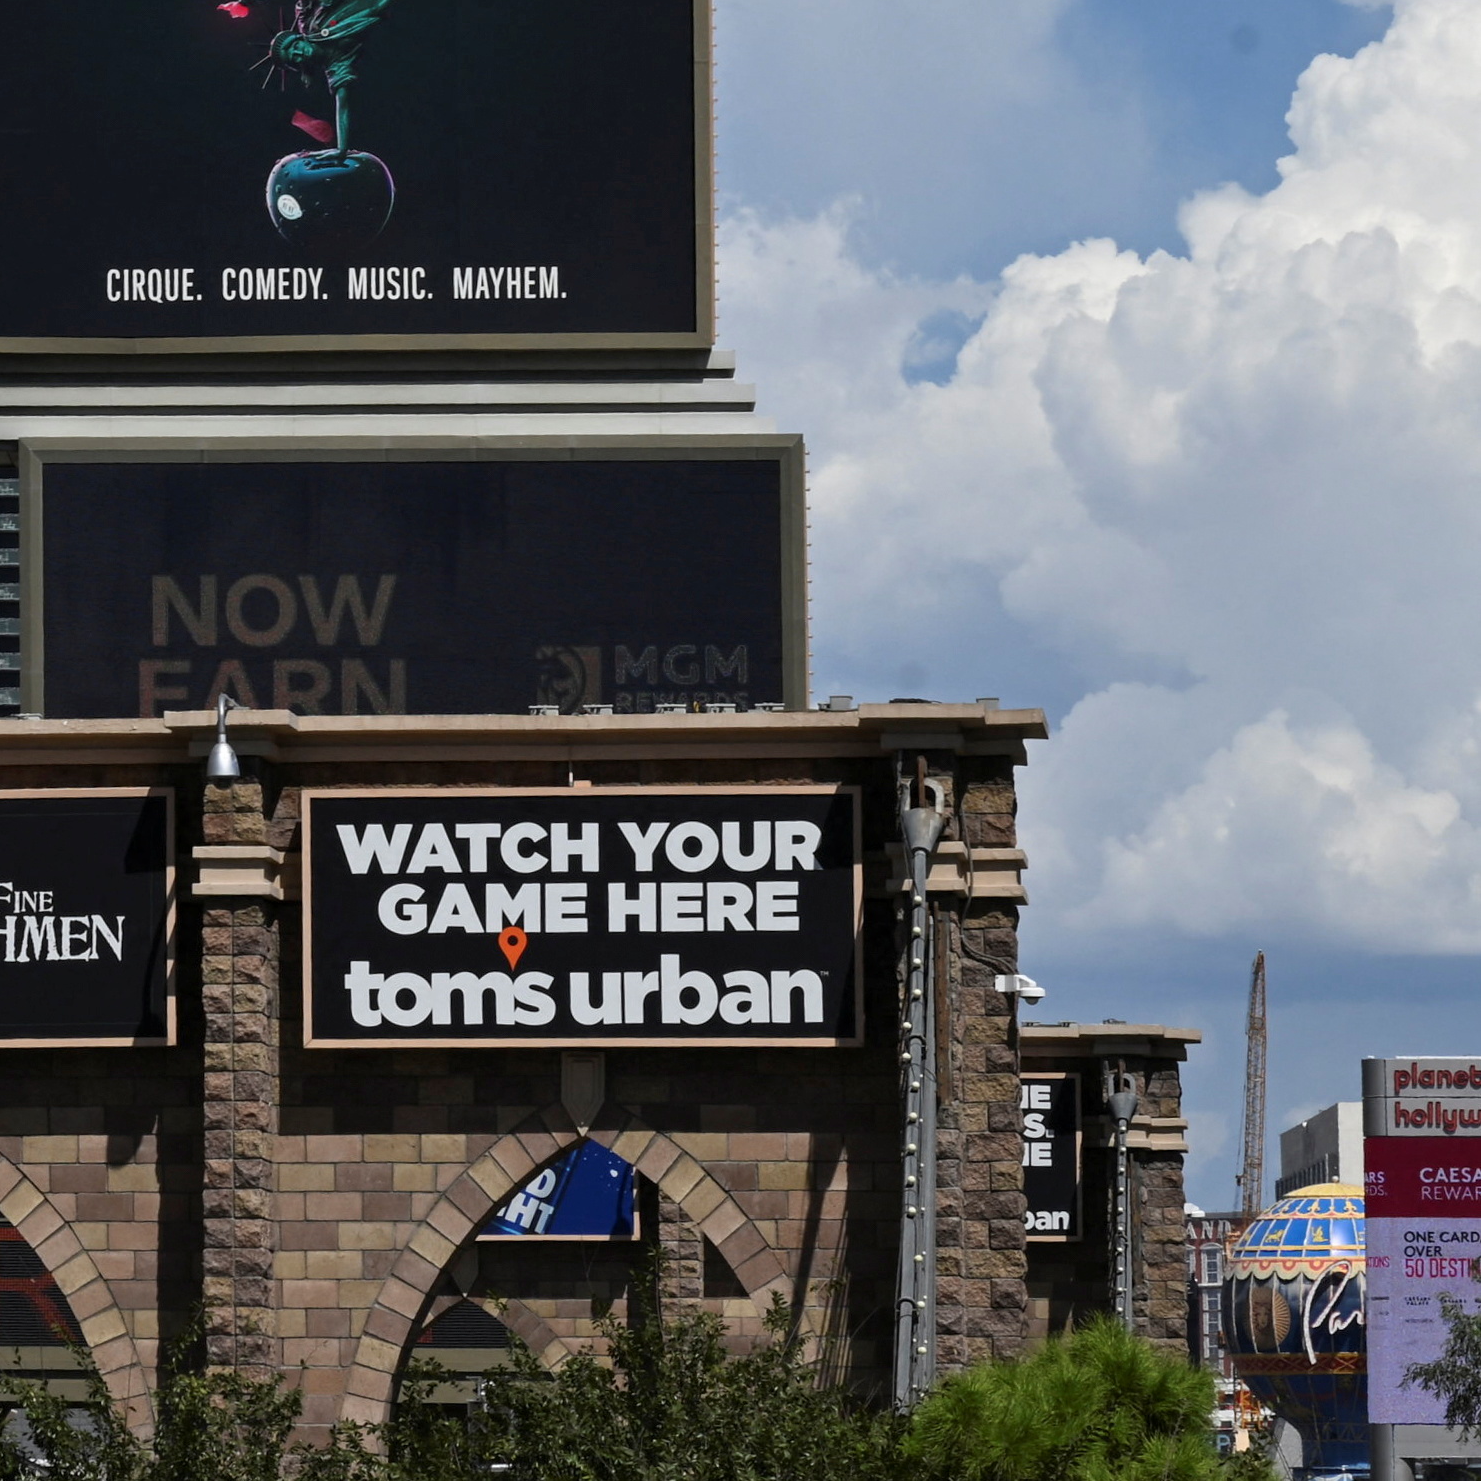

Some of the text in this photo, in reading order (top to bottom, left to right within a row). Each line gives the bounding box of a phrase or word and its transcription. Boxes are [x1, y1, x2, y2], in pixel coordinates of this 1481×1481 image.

[105, 266, 568, 303] CIRQUE. COMEDY. MUSIC. MAYHEM.
[151, 573, 398, 647] NOW
[613, 644, 749, 686] MGM
[138, 657, 408, 719] EARN
[335, 820, 823, 875] WATCH YOUR
[377, 880, 800, 935] GAME HERE
[343, 953, 825, 1027] toms urban
[1393, 1061, 1481, 1097] planet
[496, 1192, 554, 1234] HT
[1403, 1230, 1436, 1244] ONE
[1403, 1245, 1443, 1258] OVER
[1404, 1258, 1425, 1278] 50
